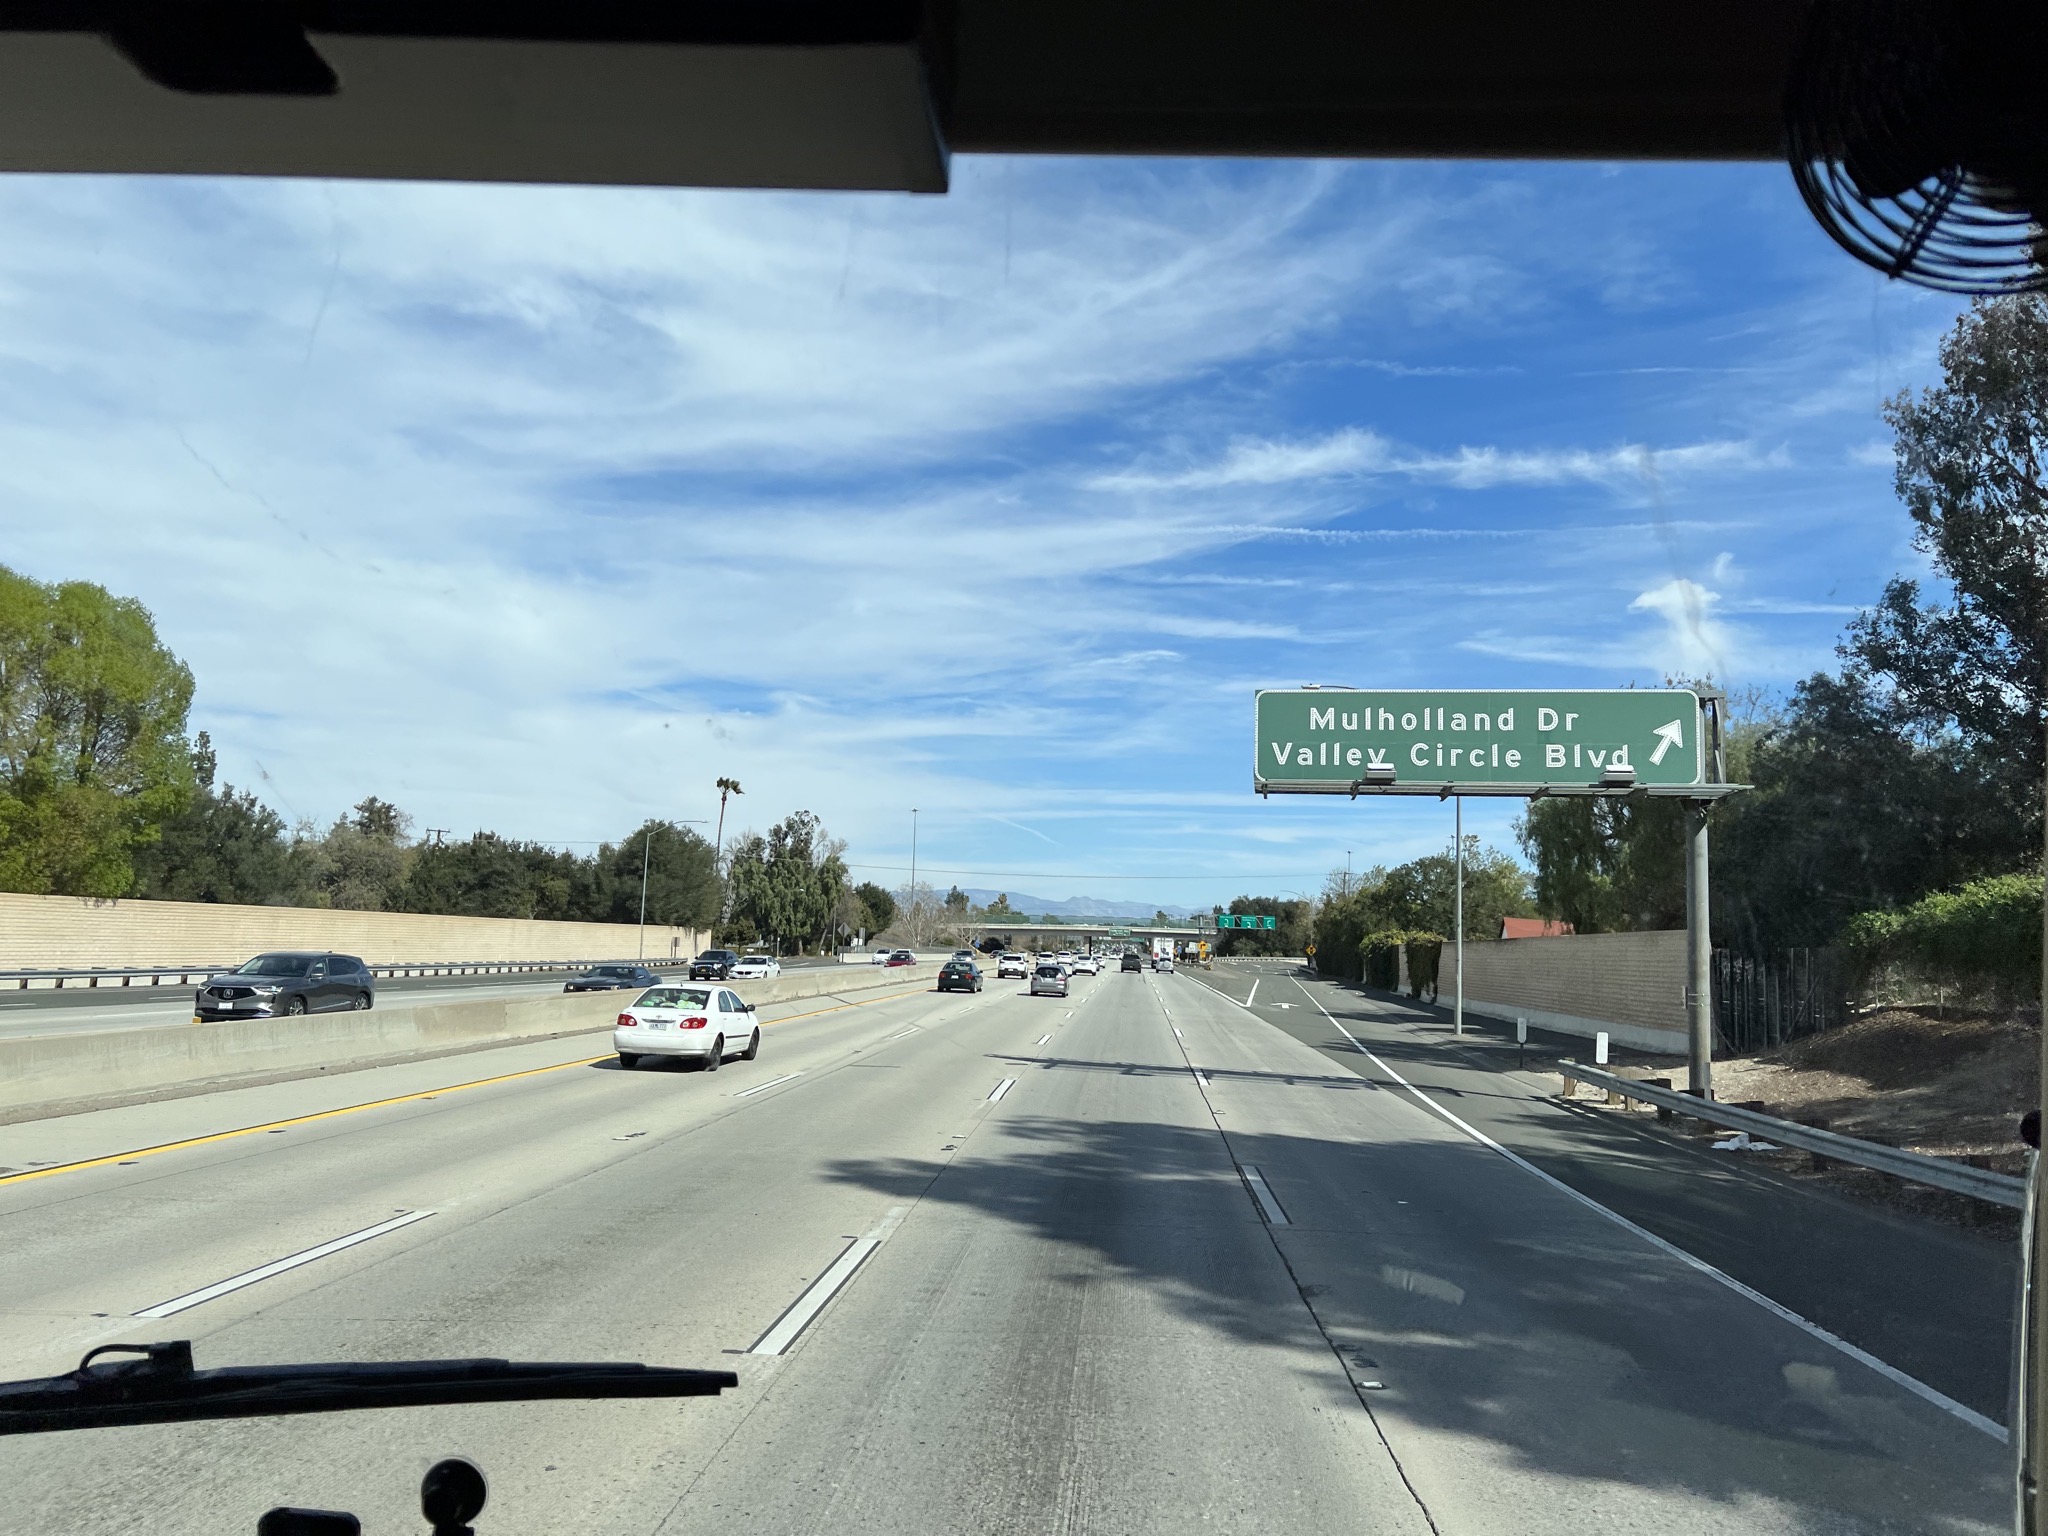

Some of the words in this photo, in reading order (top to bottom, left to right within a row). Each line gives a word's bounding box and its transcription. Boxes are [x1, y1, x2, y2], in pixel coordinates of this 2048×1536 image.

[1309, 707, 1514, 731] Mulholland
[1538, 707, 1580, 731] Dr
[1271, 742, 1387, 766] Valley
[1410, 743, 1522, 768] Circle
[1545, 743, 1629, 768] Blvd
